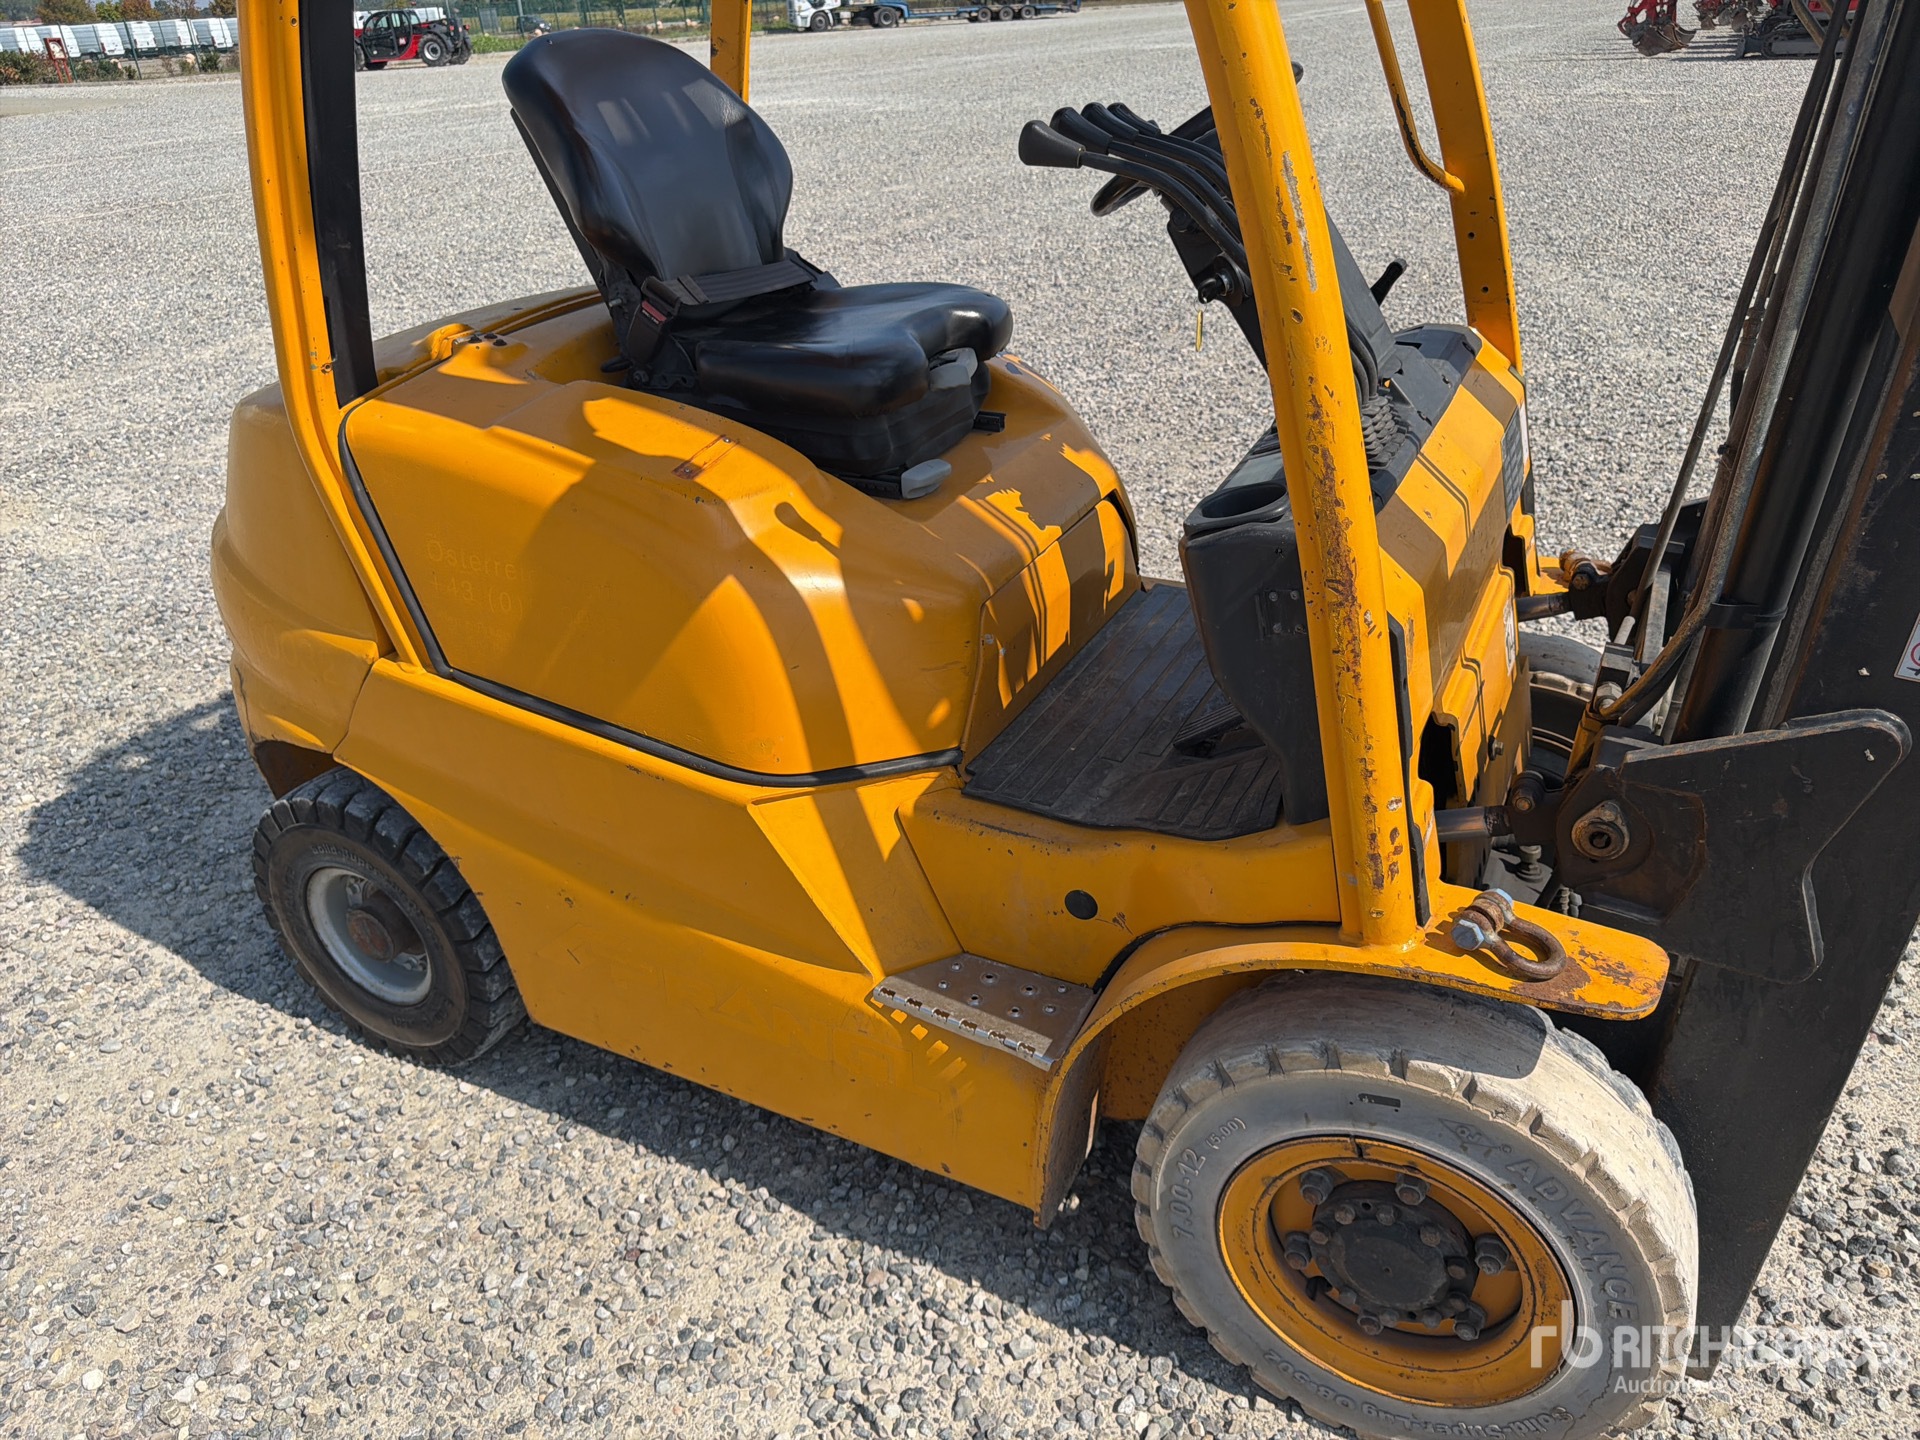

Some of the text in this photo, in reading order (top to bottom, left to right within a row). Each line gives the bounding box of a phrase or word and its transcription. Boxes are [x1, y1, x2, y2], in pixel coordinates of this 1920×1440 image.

[1169, 1116, 1247, 1240] 7.00-12 (5.00)
[1503, 1159, 1639, 1321] ADVANCE
